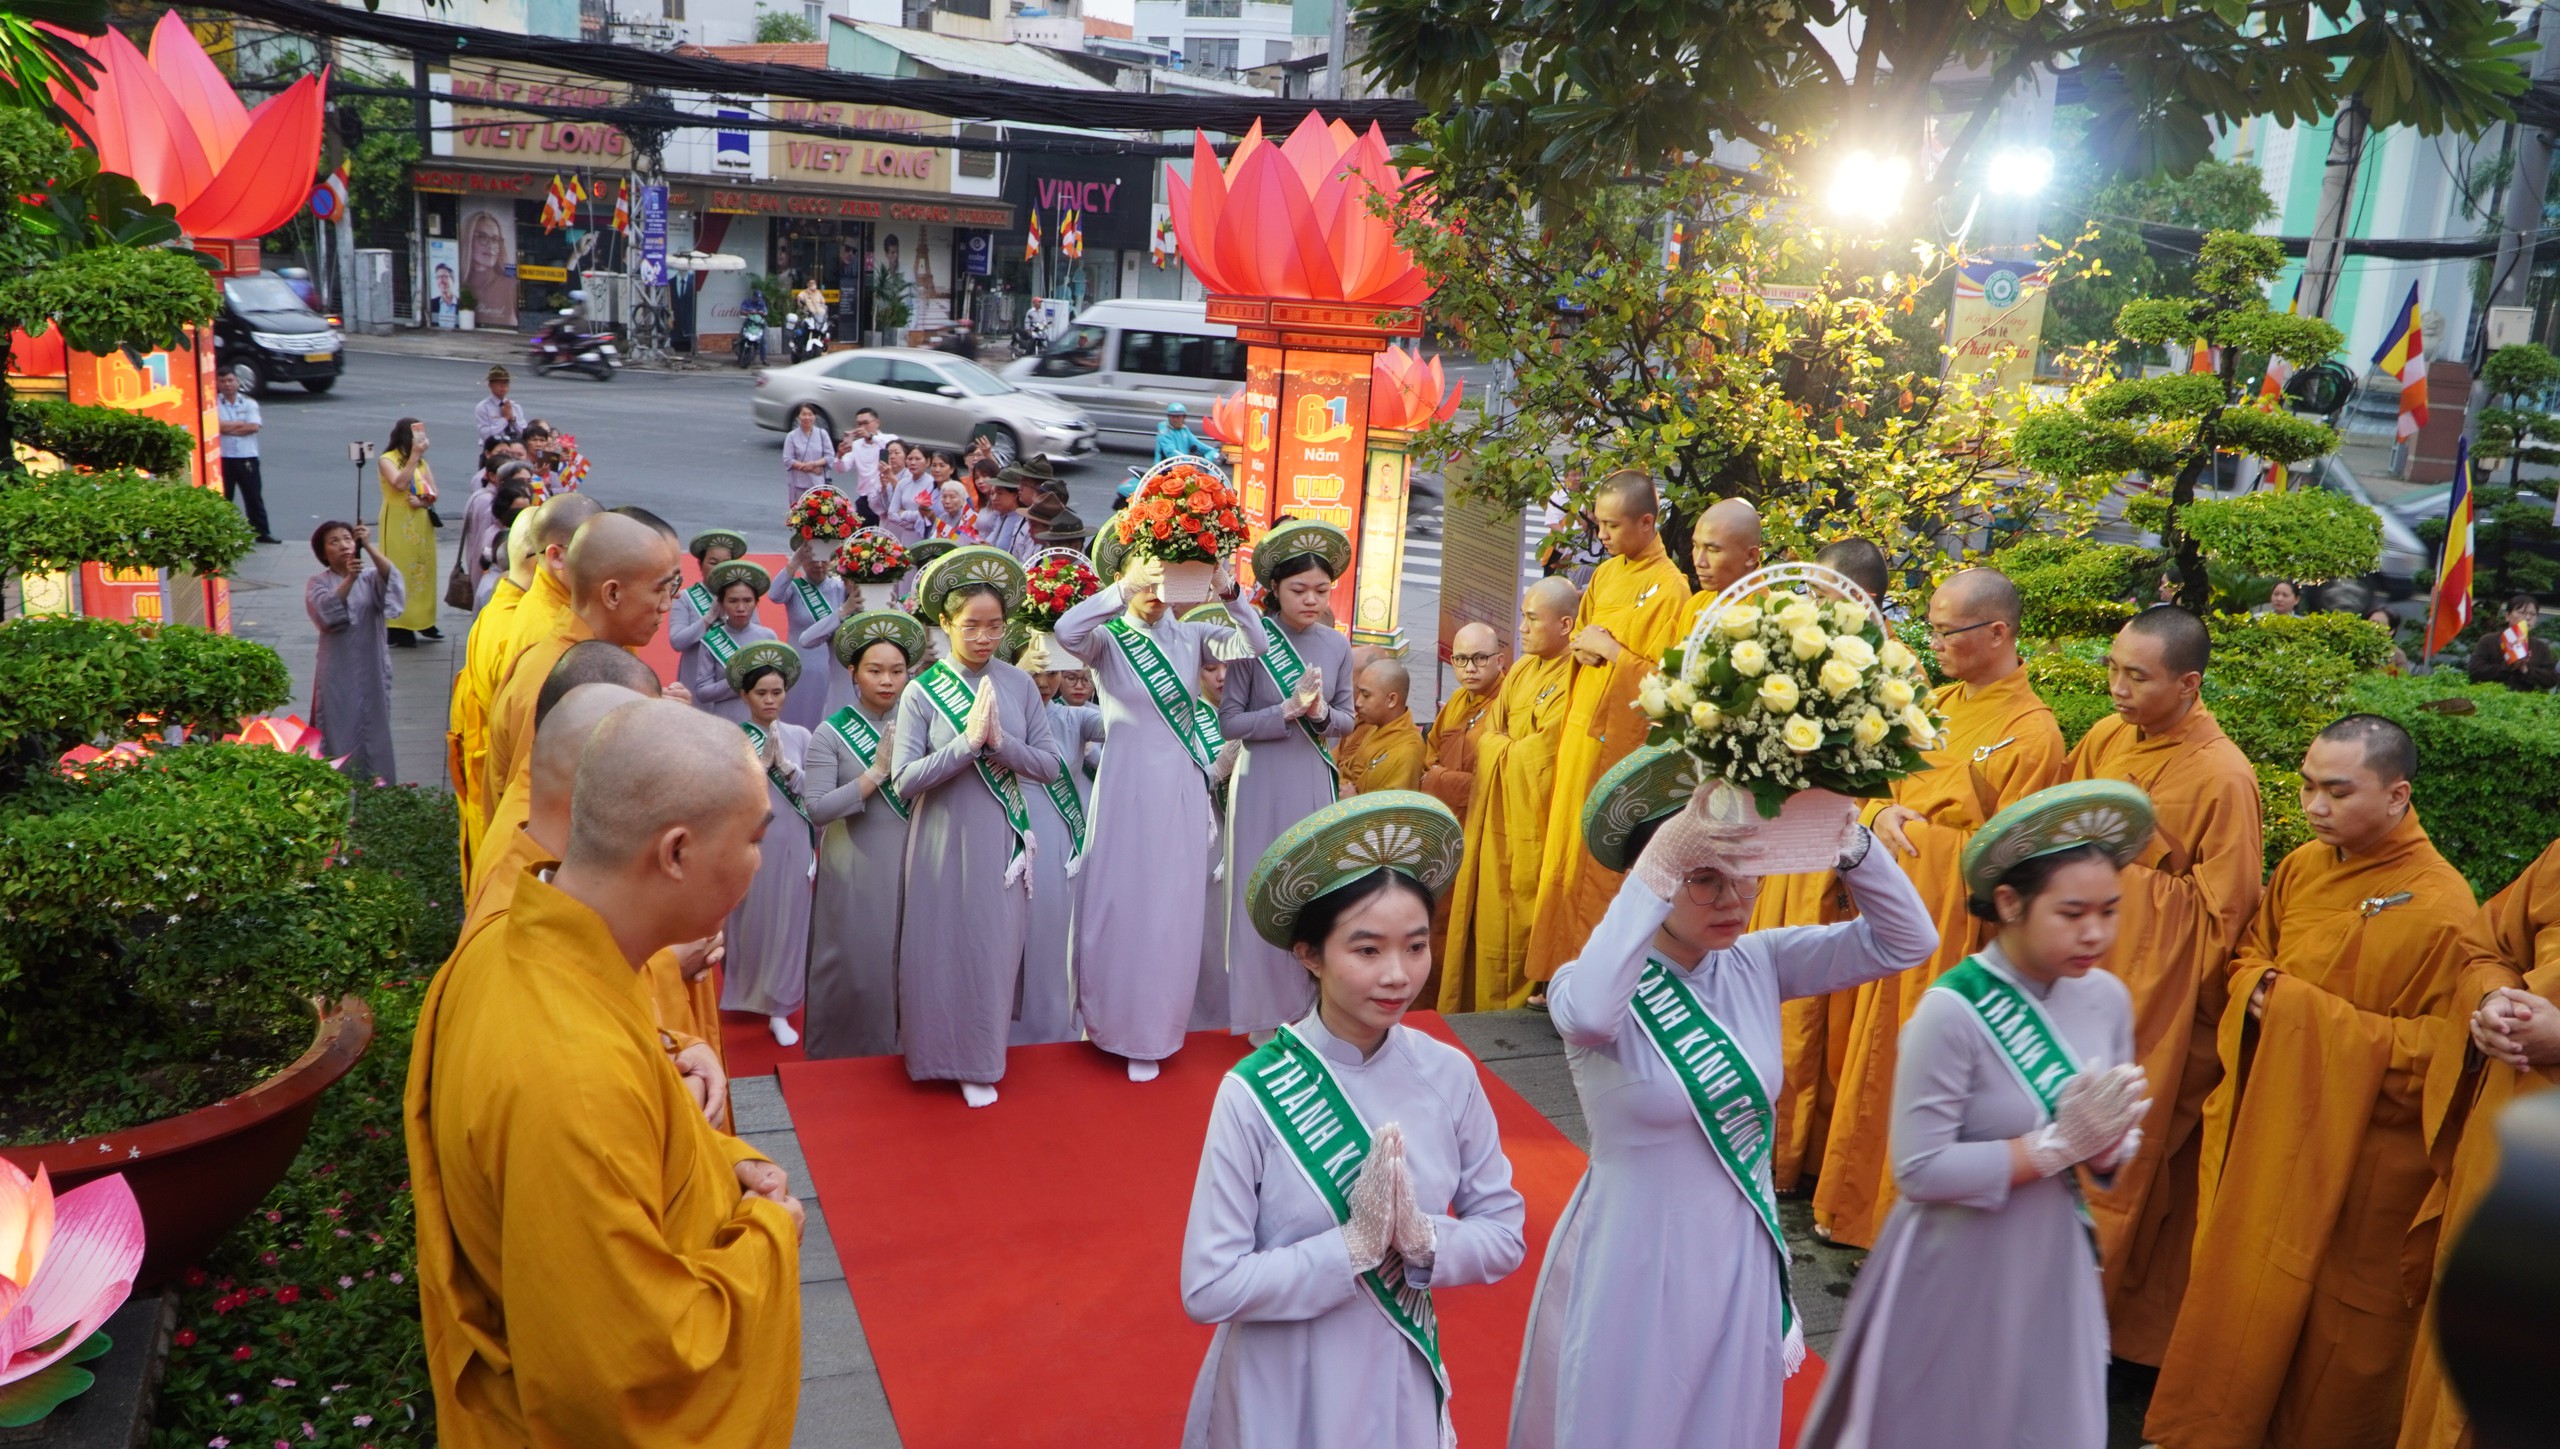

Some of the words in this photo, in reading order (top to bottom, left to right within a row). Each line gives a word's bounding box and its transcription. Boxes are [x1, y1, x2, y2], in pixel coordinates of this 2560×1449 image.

[541, 122, 625, 156] LONG
[415, 171, 464, 187] MONT
[469, 175, 523, 192] BLANC
[861, 148, 934, 179] LONG
[838, 200, 882, 218] ZEISS
[1037, 177, 1117, 213] VINCY
[1295, 393, 1348, 441] 61
[1303, 447, 1339, 462] Năm
[709, 632, 736, 659] THÀNH
[1118, 628, 1159, 673] THÀNH
[1147, 667, 1182, 706] KÍNH
[928, 672, 972, 715] THÀNH
[840, 717, 878, 754] THÀNH
[1193, 707, 1222, 744] THÀNH
[1974, 988, 2050, 1071] THÀNH
[1257, 1050, 1344, 1154] THÀNH
[1673, 1027, 1743, 1102] KÍNH
[1714, 1095, 1767, 1164] CÚNG
